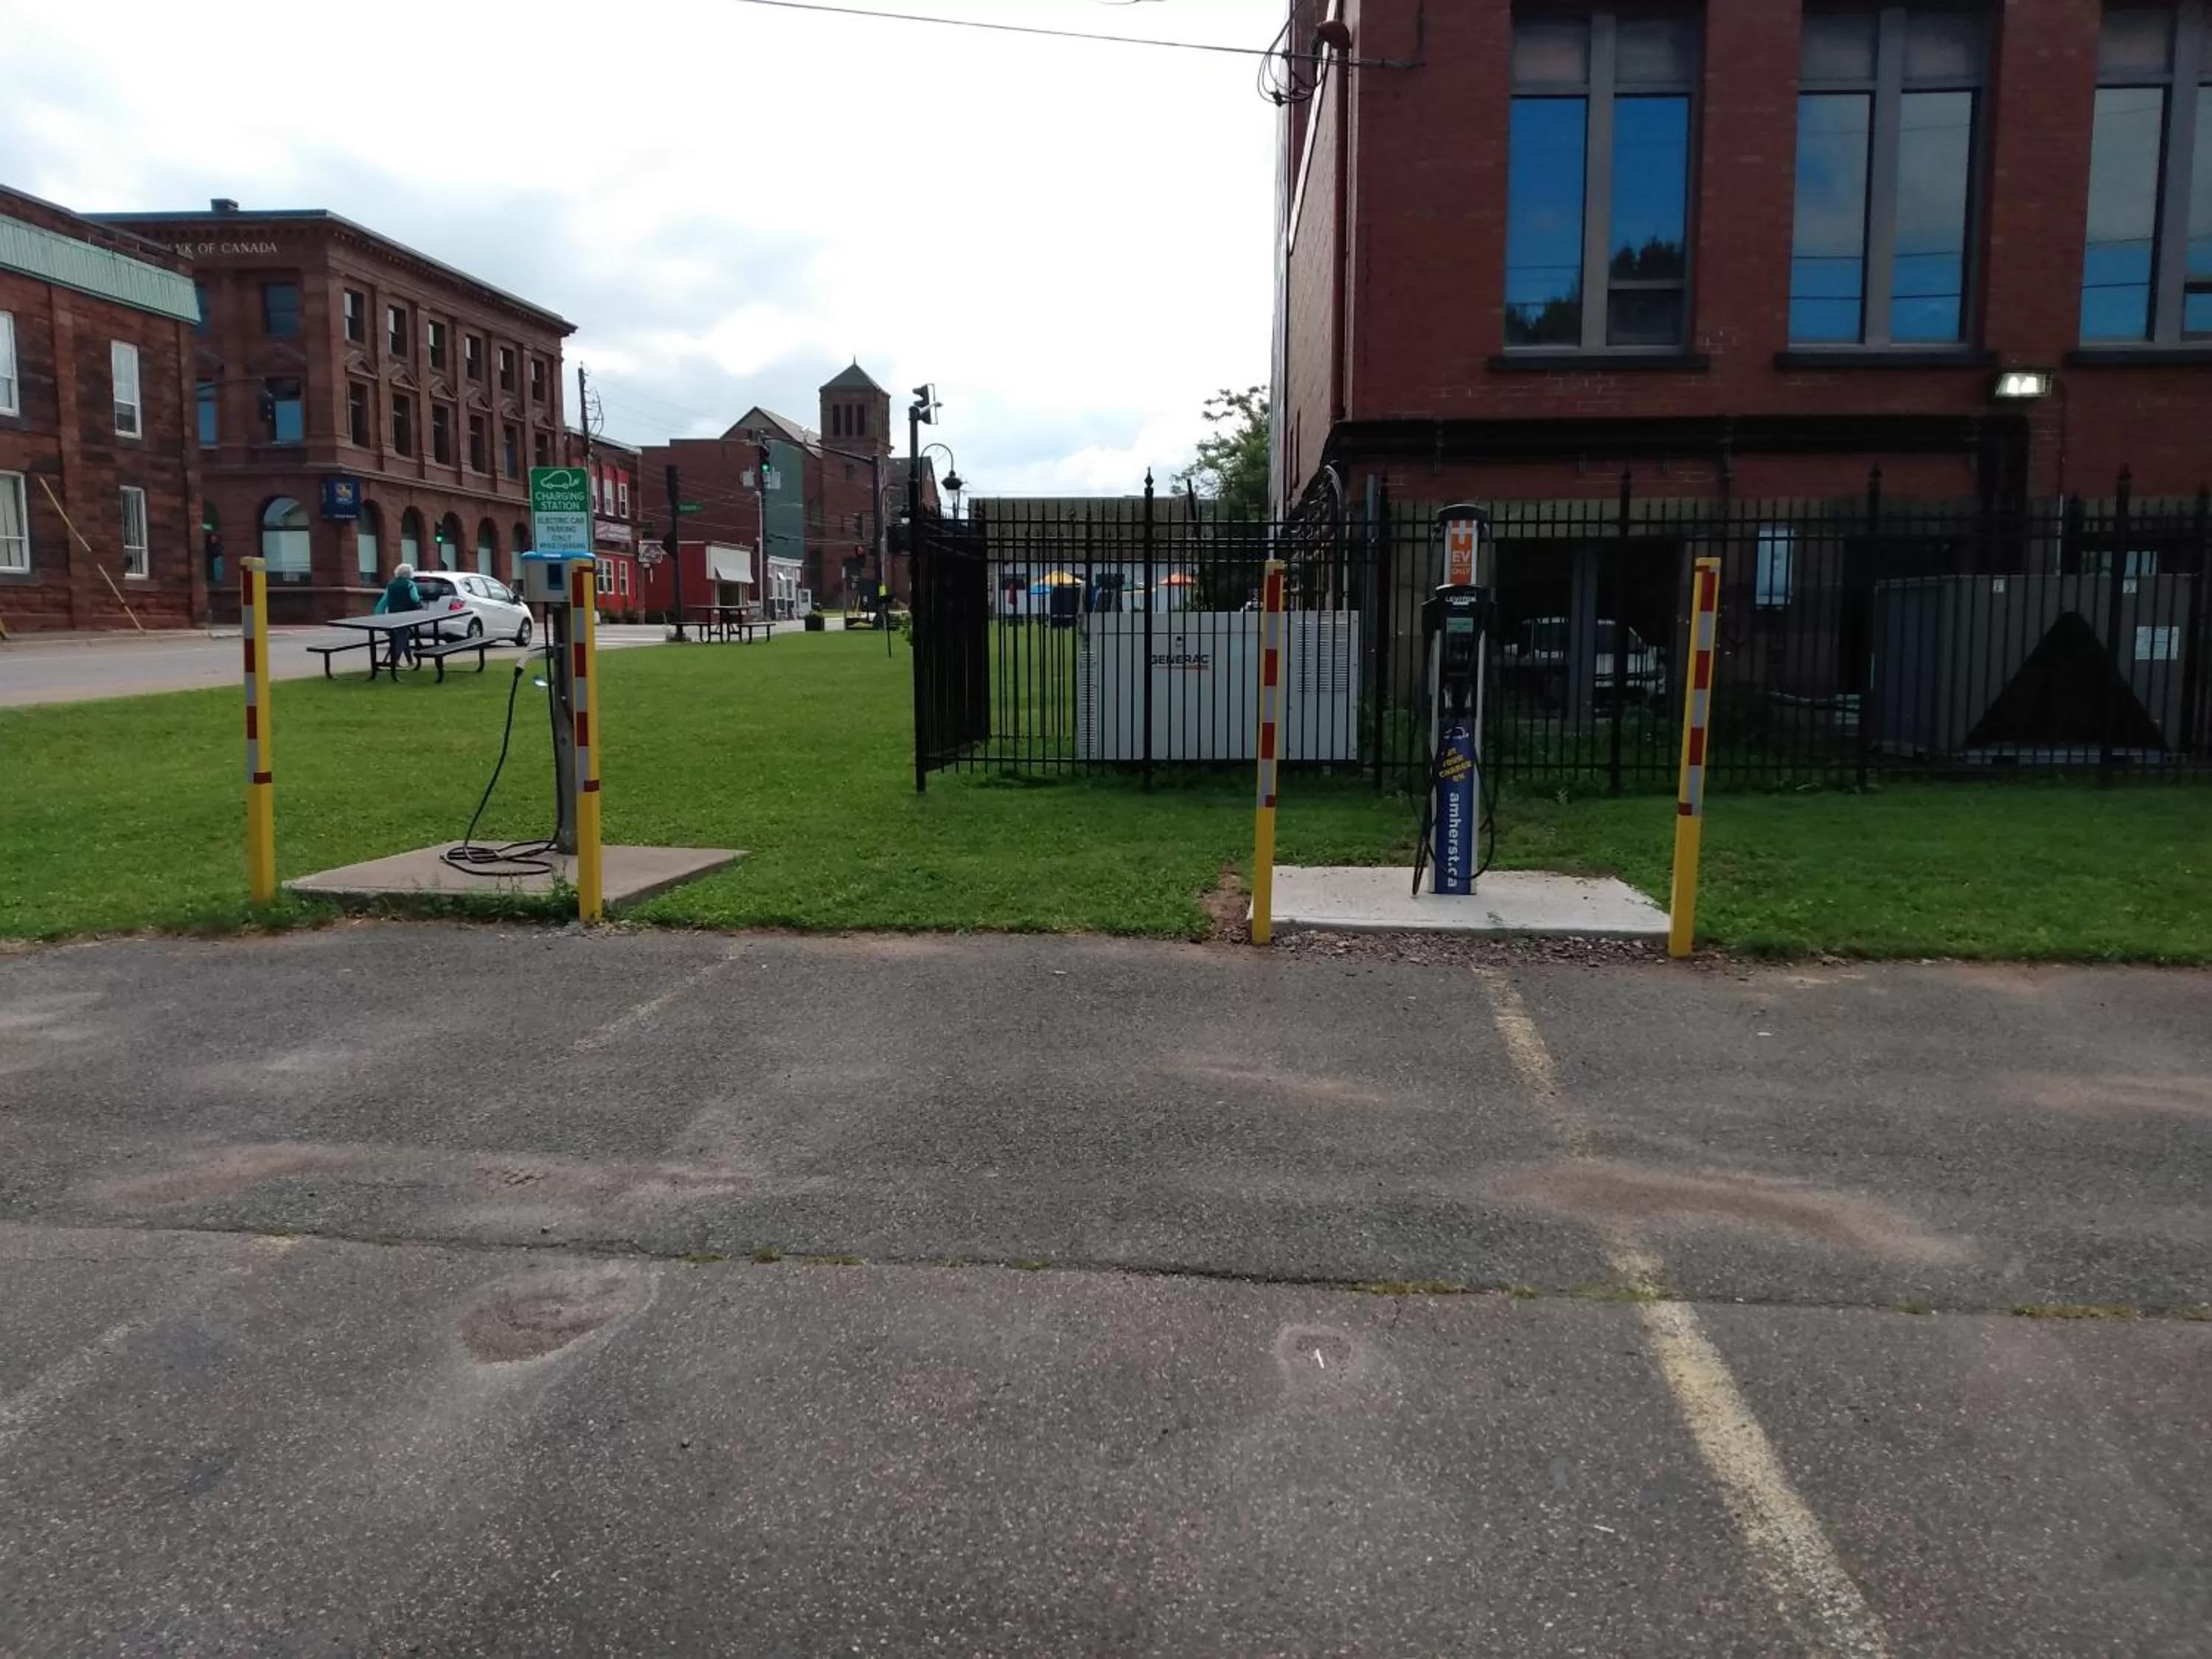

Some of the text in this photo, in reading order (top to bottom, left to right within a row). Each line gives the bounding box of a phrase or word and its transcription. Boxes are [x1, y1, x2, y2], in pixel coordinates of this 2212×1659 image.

[198, 243, 215, 254] OF
[221, 241, 277, 254] CANADA
[535, 492, 585, 501] CHARGING
[540, 501, 580, 510] STATION
[1452, 551, 1471, 563] EV
[1450, 567, 1471, 575] ONLY
[1150, 654, 1211, 664] GENERAC
[1439, 760, 1472, 778] CHARGE
[1447, 792, 1462, 888] amherst.ca
